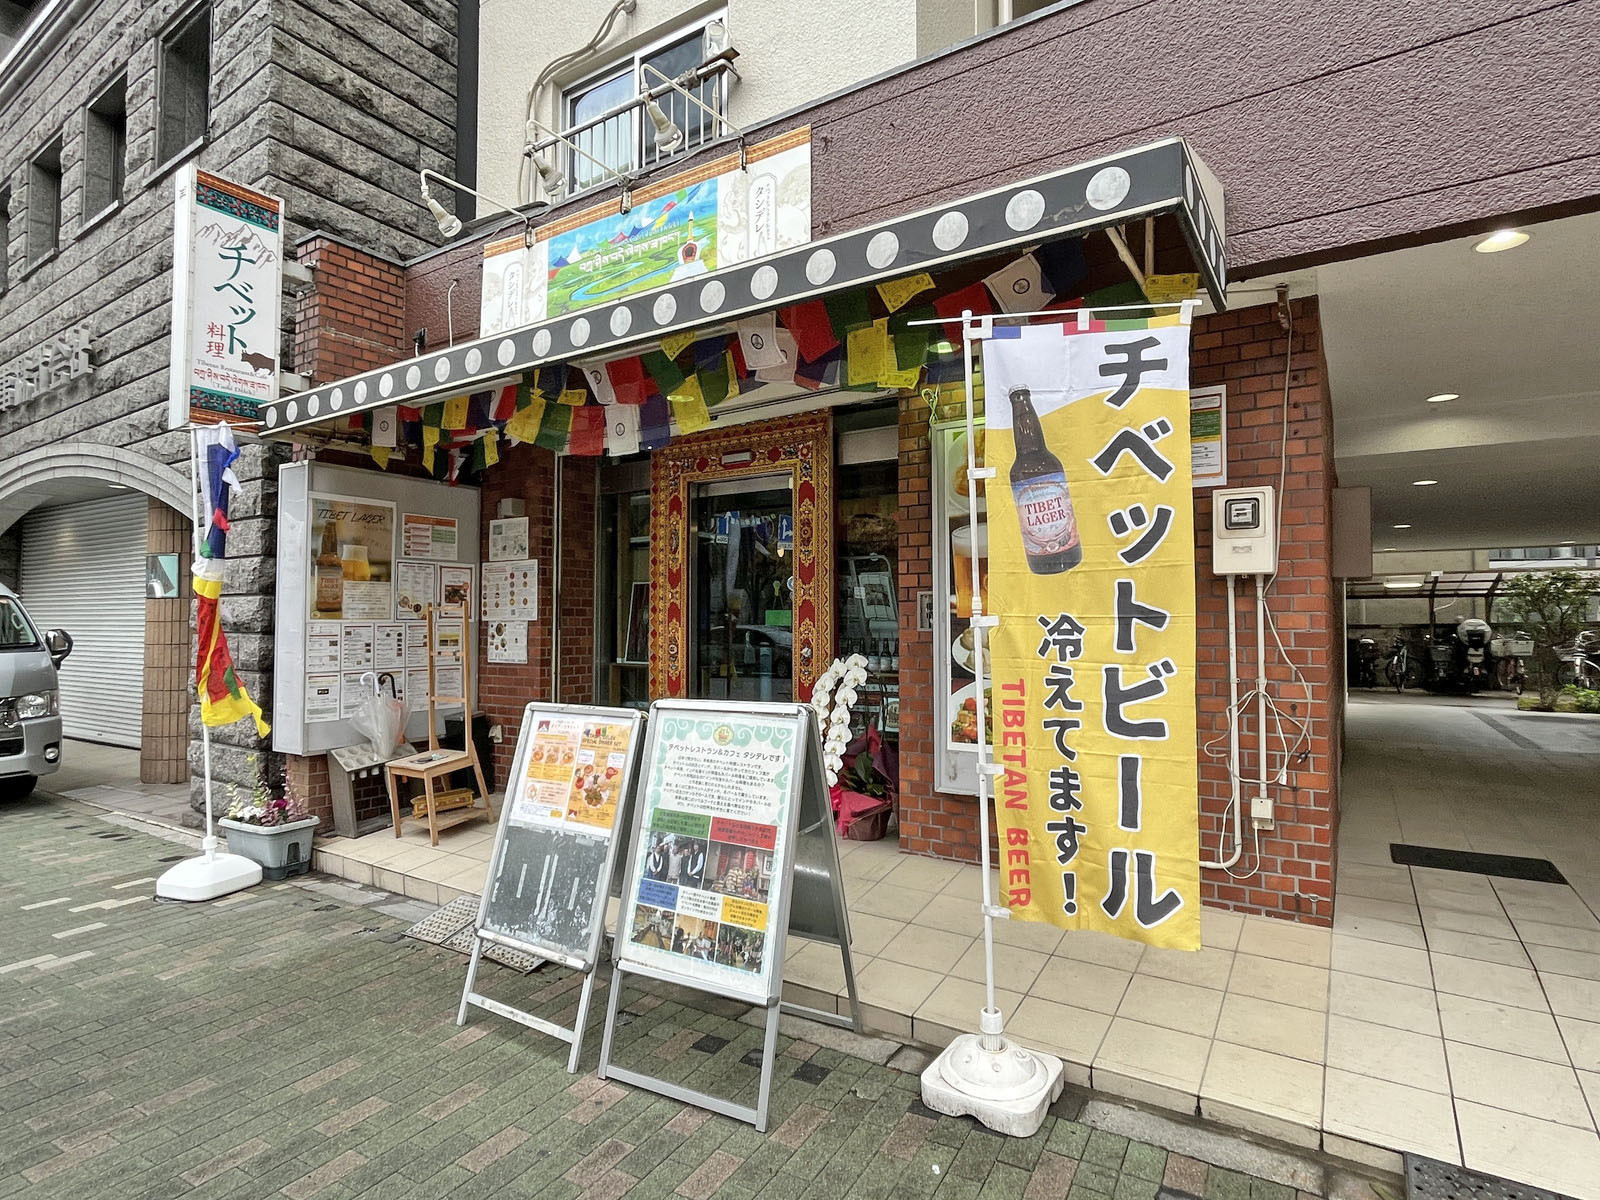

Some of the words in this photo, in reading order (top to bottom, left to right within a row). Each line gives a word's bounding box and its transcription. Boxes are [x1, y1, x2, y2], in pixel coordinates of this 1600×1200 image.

[755, 186, 766, 232] タシデレ
[213, 243, 257, 354] チベット
[206, 321, 227, 359] 料理
[317, 508, 352, 520] TIBET
[350, 512, 386, 524] LAGER
[1025, 497, 1062, 515] TIBET
[1027, 509, 1066, 527] LAGER
[1094, 336, 1181, 926] チベットビール
[1001, 678, 1028, 810] TIBETAN
[1037, 614, 1086, 915] 冷えてます！
[1007, 827, 1031, 907] BEER
